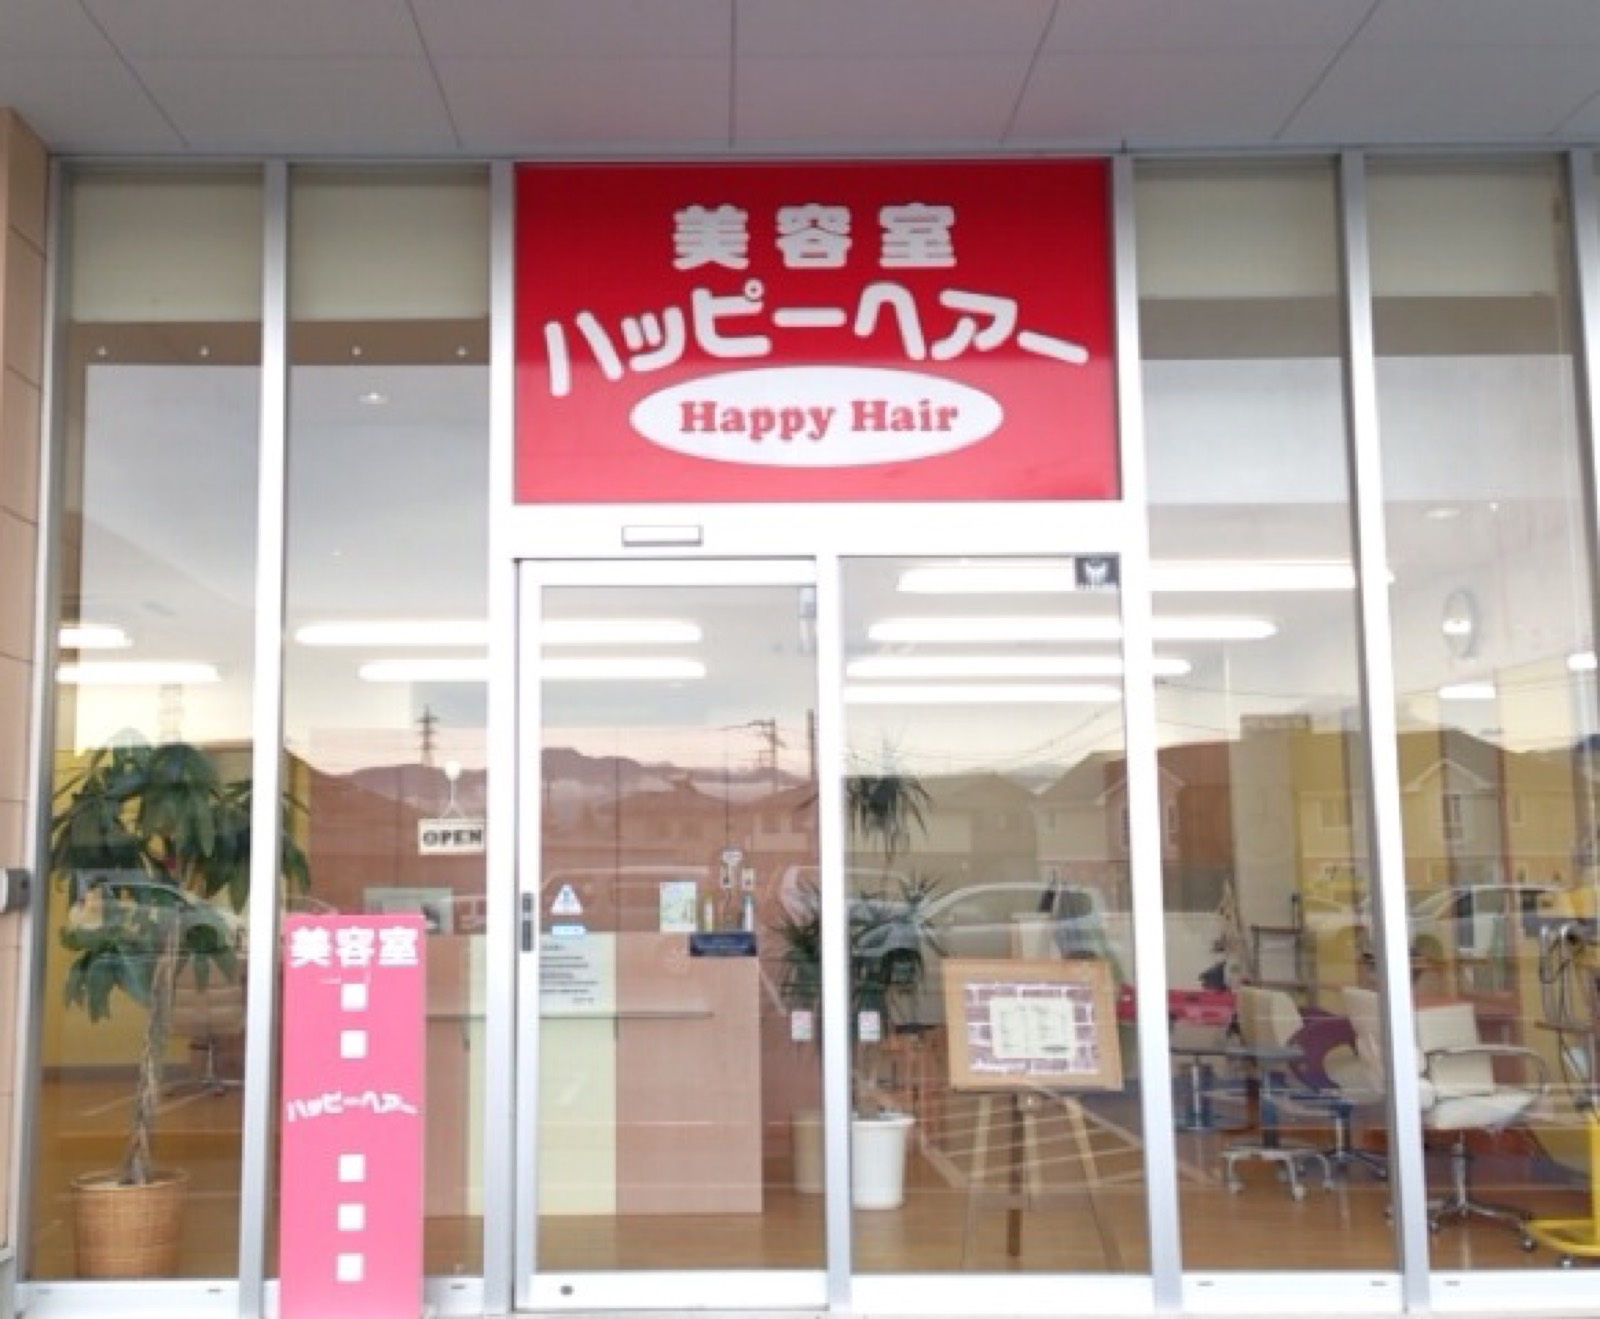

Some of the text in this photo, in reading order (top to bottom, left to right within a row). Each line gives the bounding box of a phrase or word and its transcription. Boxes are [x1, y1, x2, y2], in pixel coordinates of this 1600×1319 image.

[673, 203, 957, 270] 美容室
[545, 280, 1089, 397] ハッピーヘアー
[679, 399, 959, 442] Happy Hair
[422, 829, 482, 846] OPEN
[290, 925, 419, 968] 美容室
